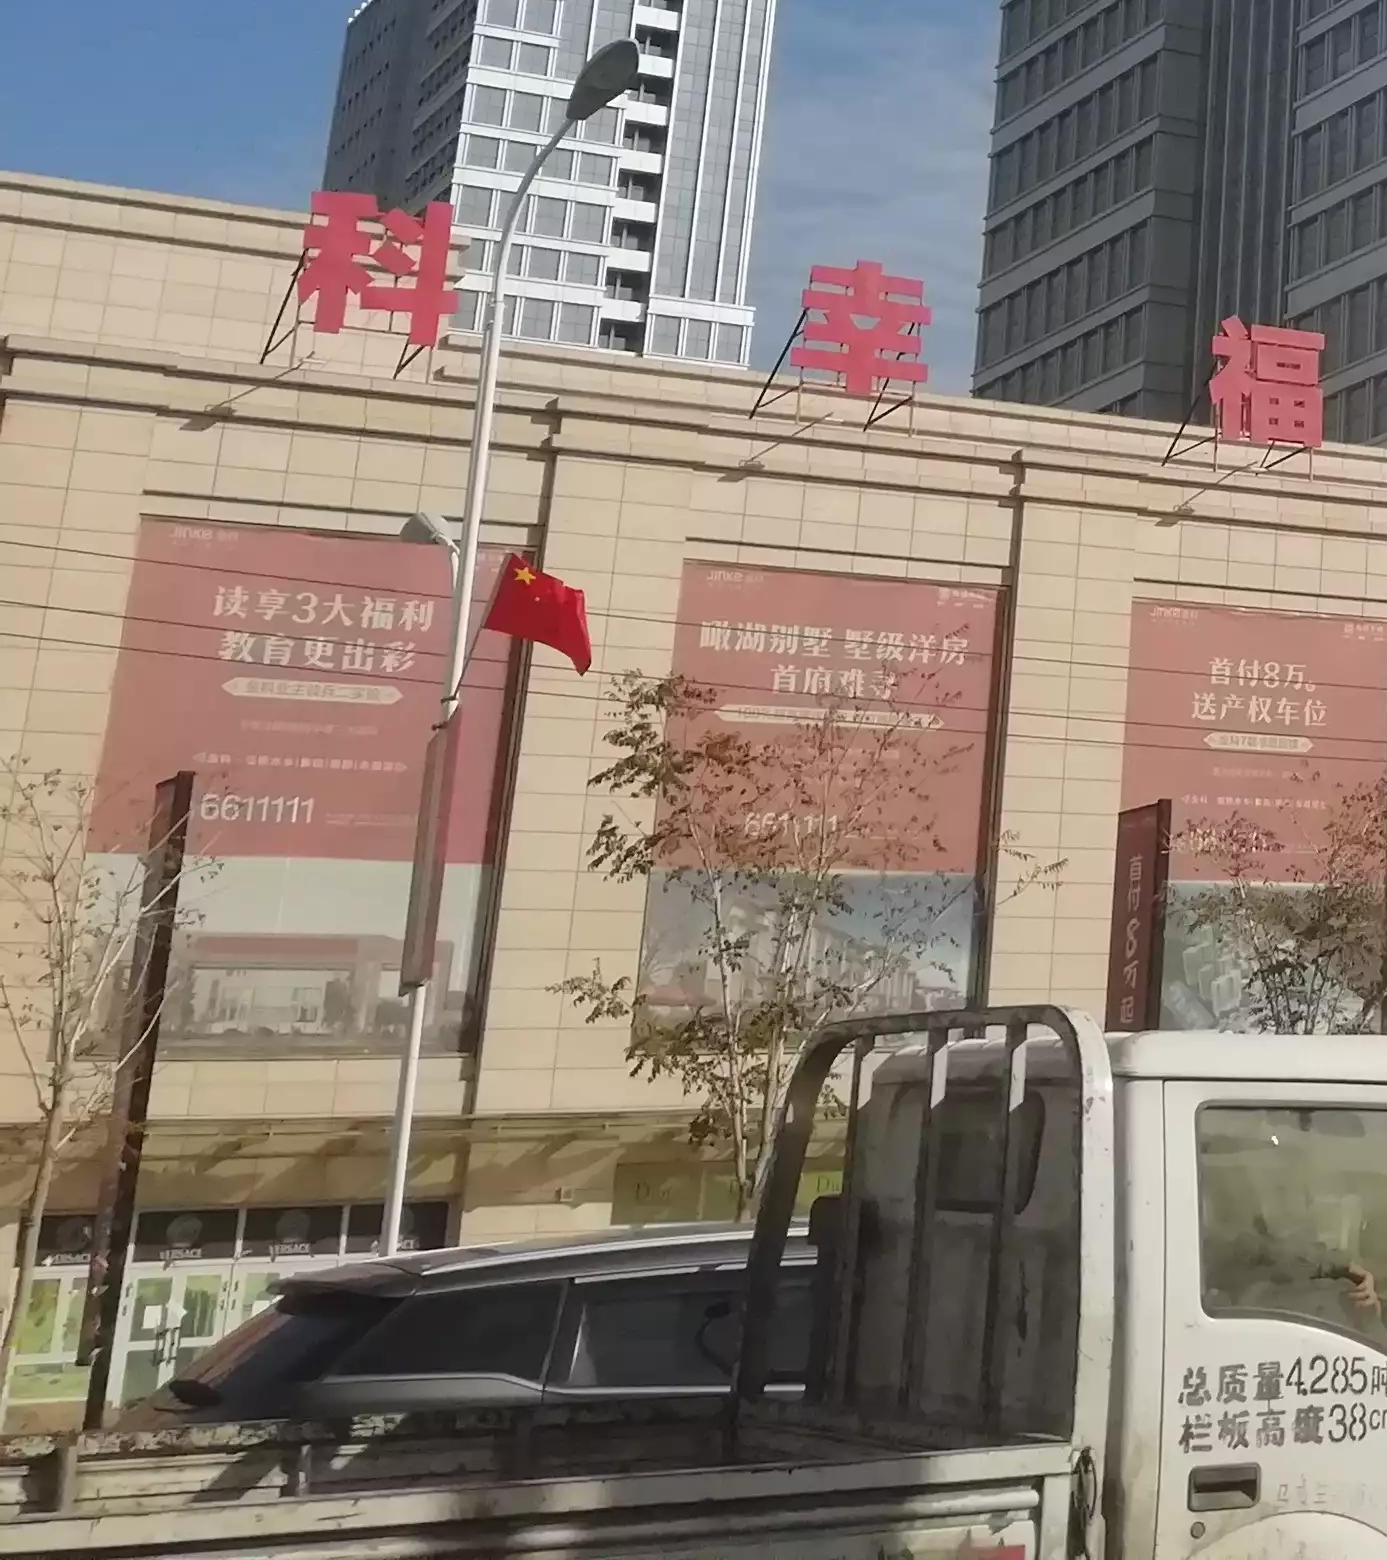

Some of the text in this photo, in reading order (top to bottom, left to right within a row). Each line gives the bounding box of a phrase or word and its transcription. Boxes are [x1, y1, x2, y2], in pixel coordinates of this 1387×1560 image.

[213, 585, 435, 632] 读享3大福利
[217, 630, 417, 673] 教育更出彩
[1191, 692, 1328, 727] 送产权车位
[201, 793, 315, 825] 6611111
[1119, 855, 1144, 1024] 首付8万起
